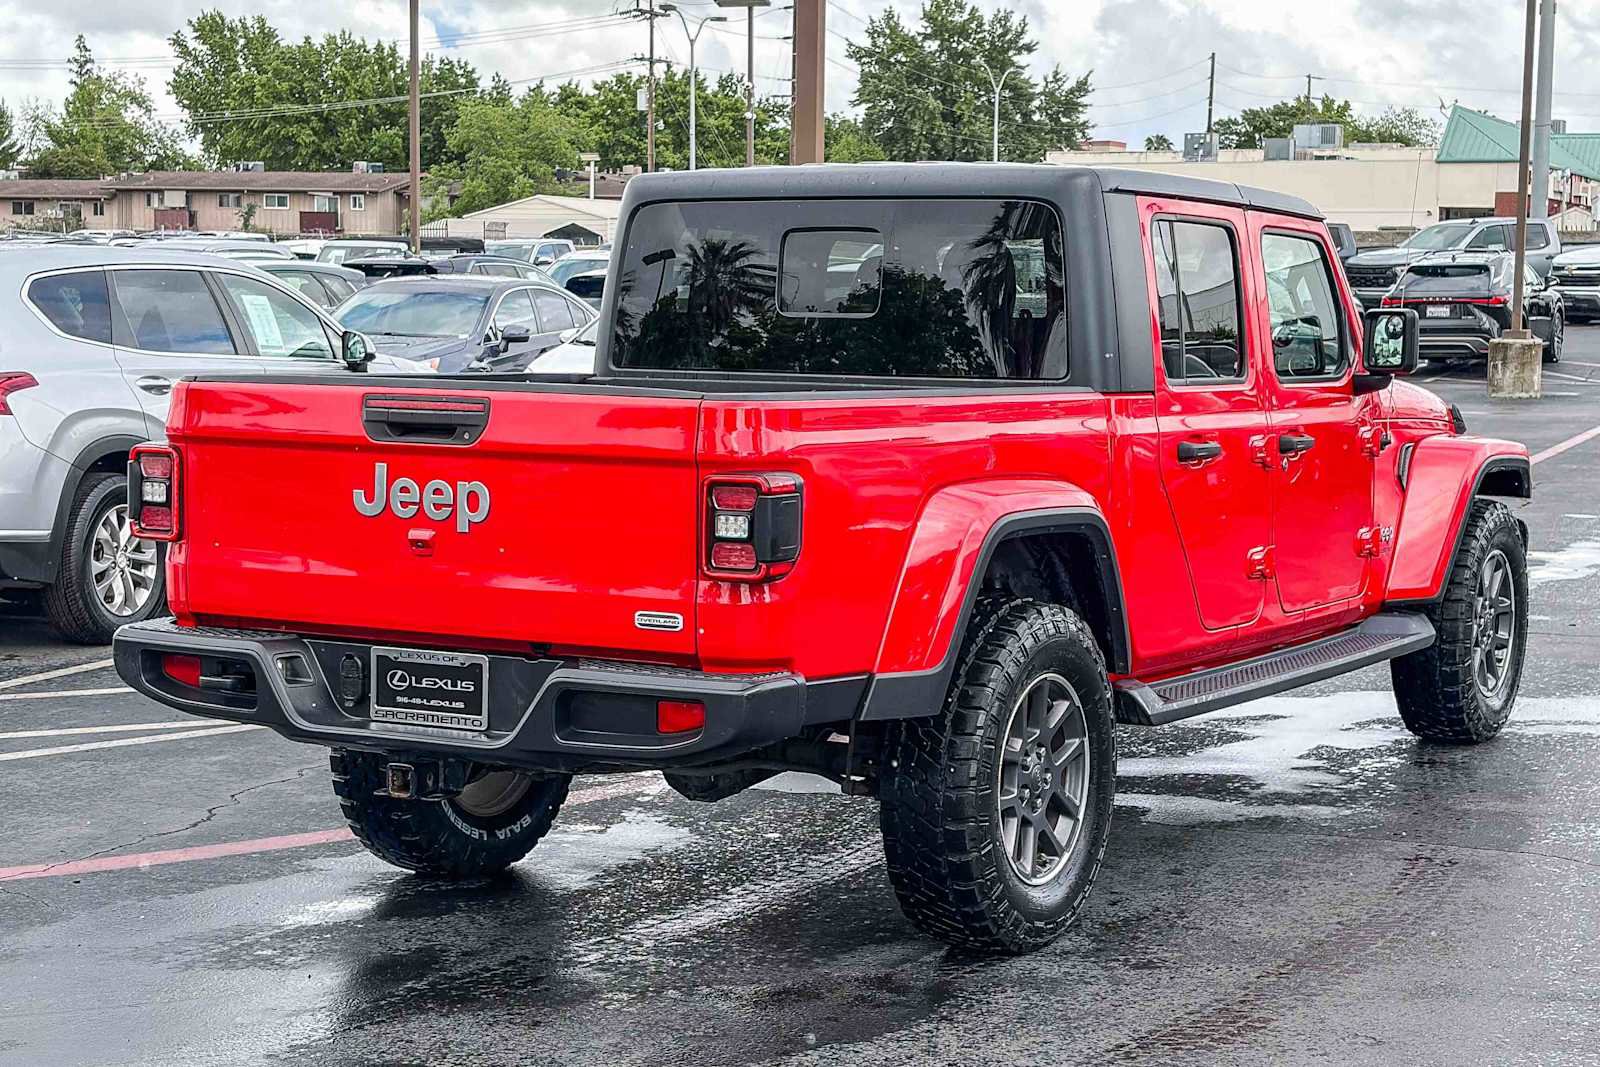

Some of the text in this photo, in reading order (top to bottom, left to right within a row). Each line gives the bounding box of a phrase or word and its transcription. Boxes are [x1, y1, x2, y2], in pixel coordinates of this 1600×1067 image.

[353, 462, 490, 533] Jeep
[400, 651, 459, 663] LEXUS OF
[411, 676, 475, 692] LEXUS
[374, 709, 483, 727] SACRAMENTO
[441, 799, 532, 841] BAJA LEGEND
